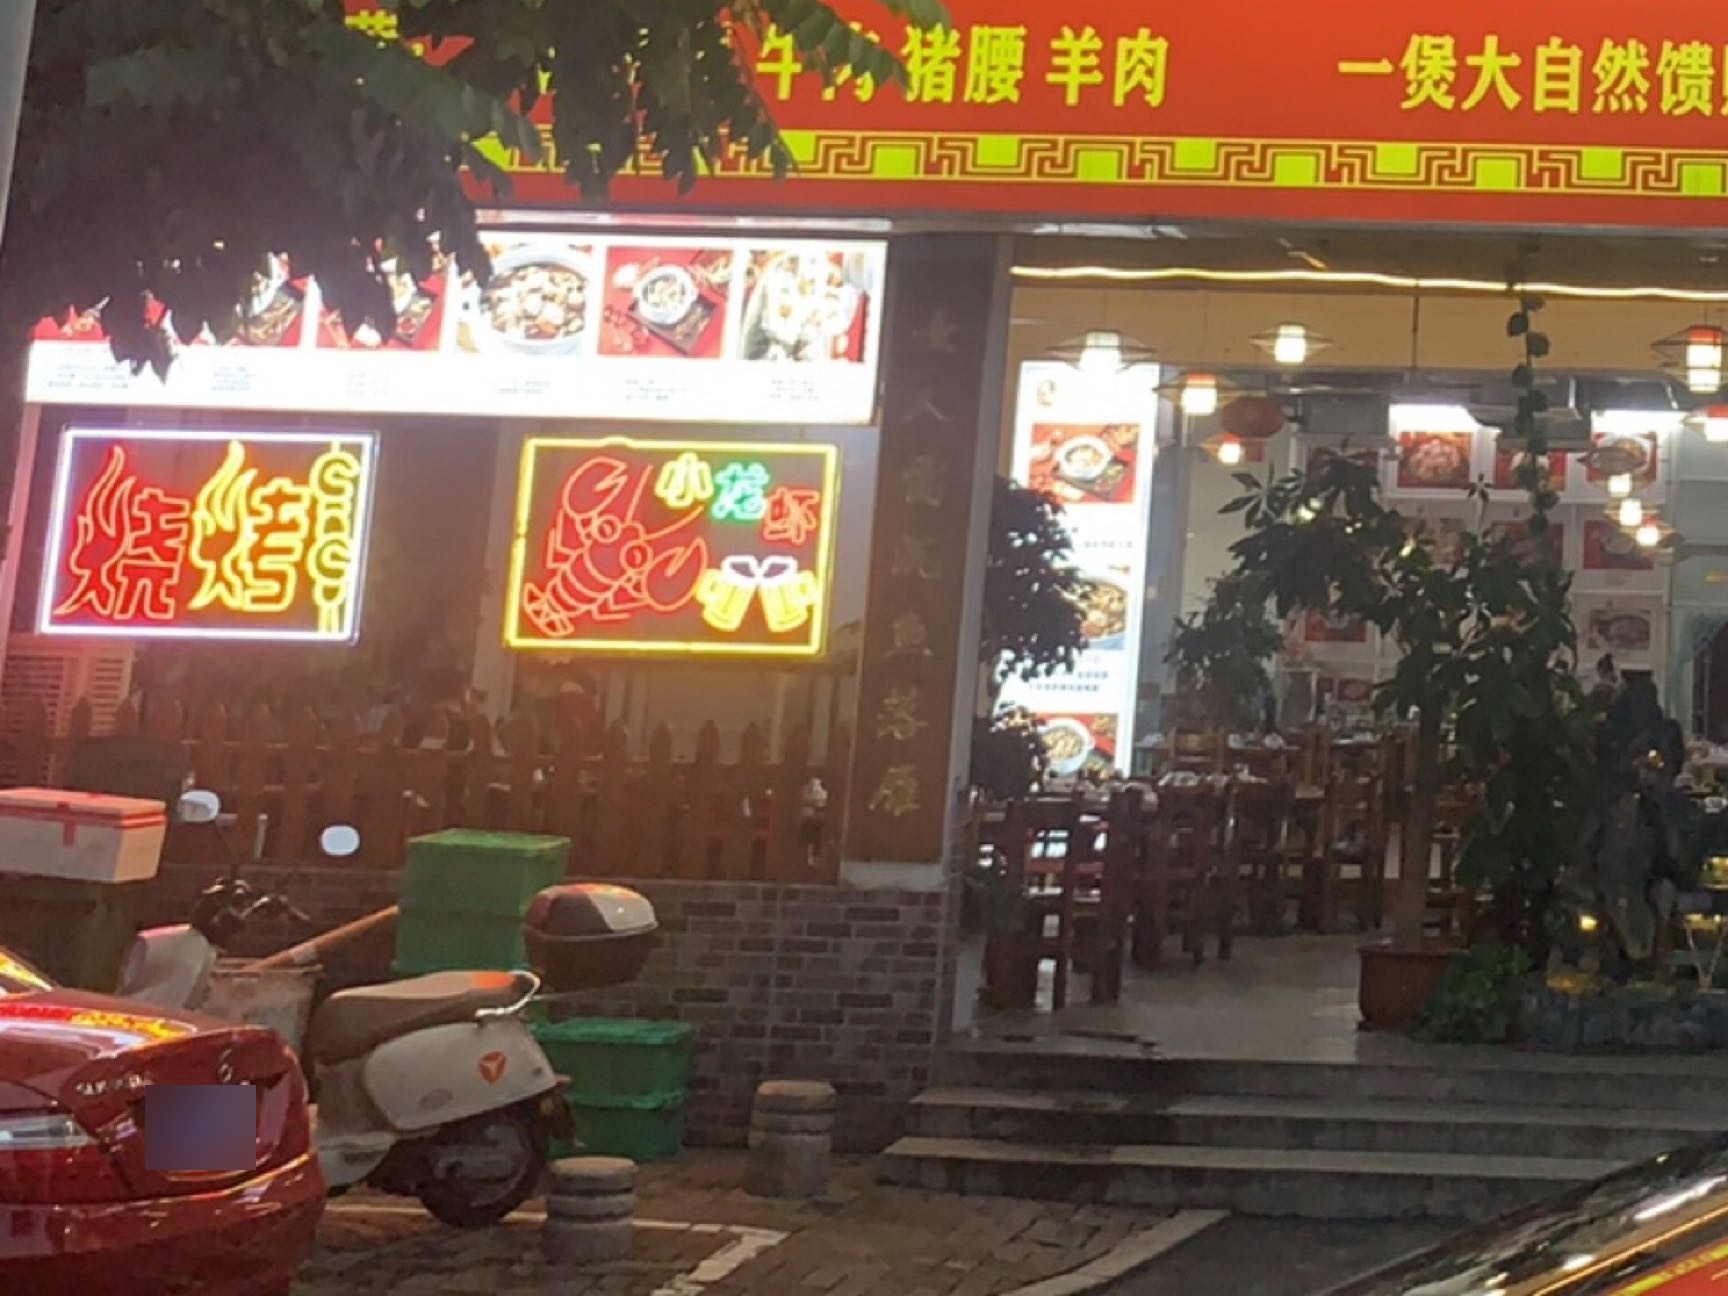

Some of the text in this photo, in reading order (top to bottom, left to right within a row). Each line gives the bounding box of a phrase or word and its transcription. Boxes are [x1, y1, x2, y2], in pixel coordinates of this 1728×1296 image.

[902, 21, 1028, 104] 猪腰
[1045, 26, 1169, 108] 羊肉
[53, 439, 314, 620] 烧烤
[655, 452, 820, 544] 小龙虾
